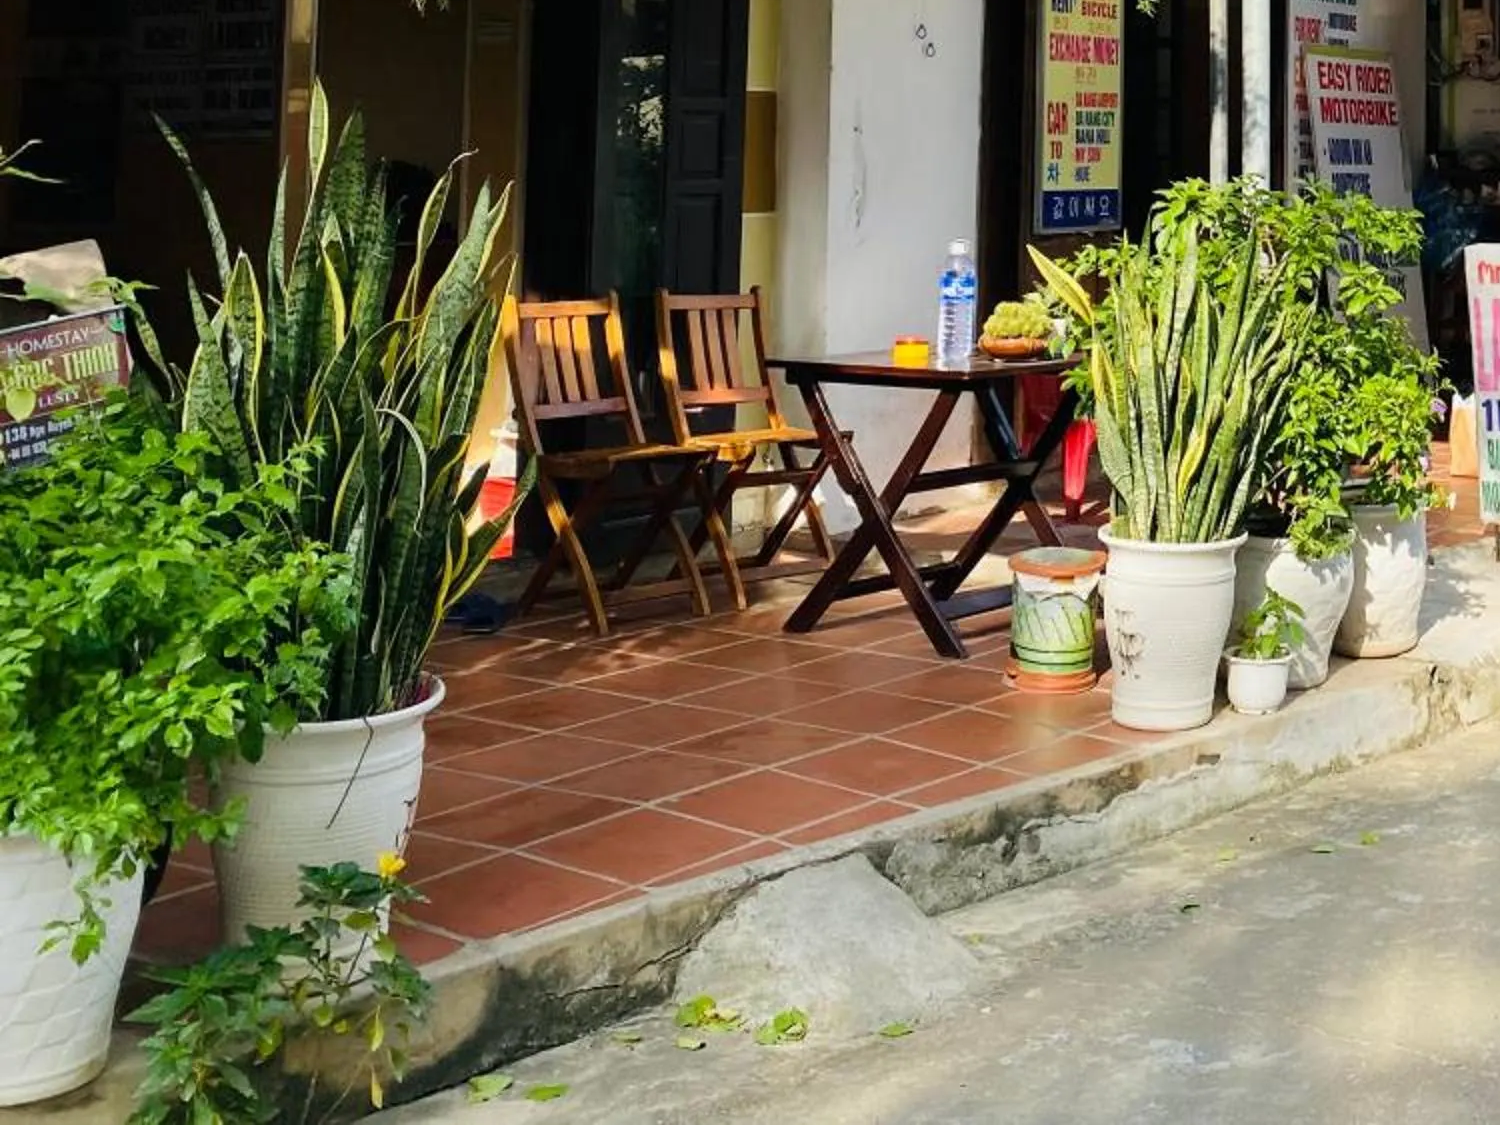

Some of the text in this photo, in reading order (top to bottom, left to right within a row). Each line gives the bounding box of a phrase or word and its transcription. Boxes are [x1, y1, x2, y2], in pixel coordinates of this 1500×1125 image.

[1317, 61, 1352, 92] EASY
[1355, 65, 1393, 94] RIDER
[1047, 102, 1068, 134] CAR
[1320, 97, 1399, 126] MOTORBIKE
[7, 327, 89, 358] HOMESTAY
